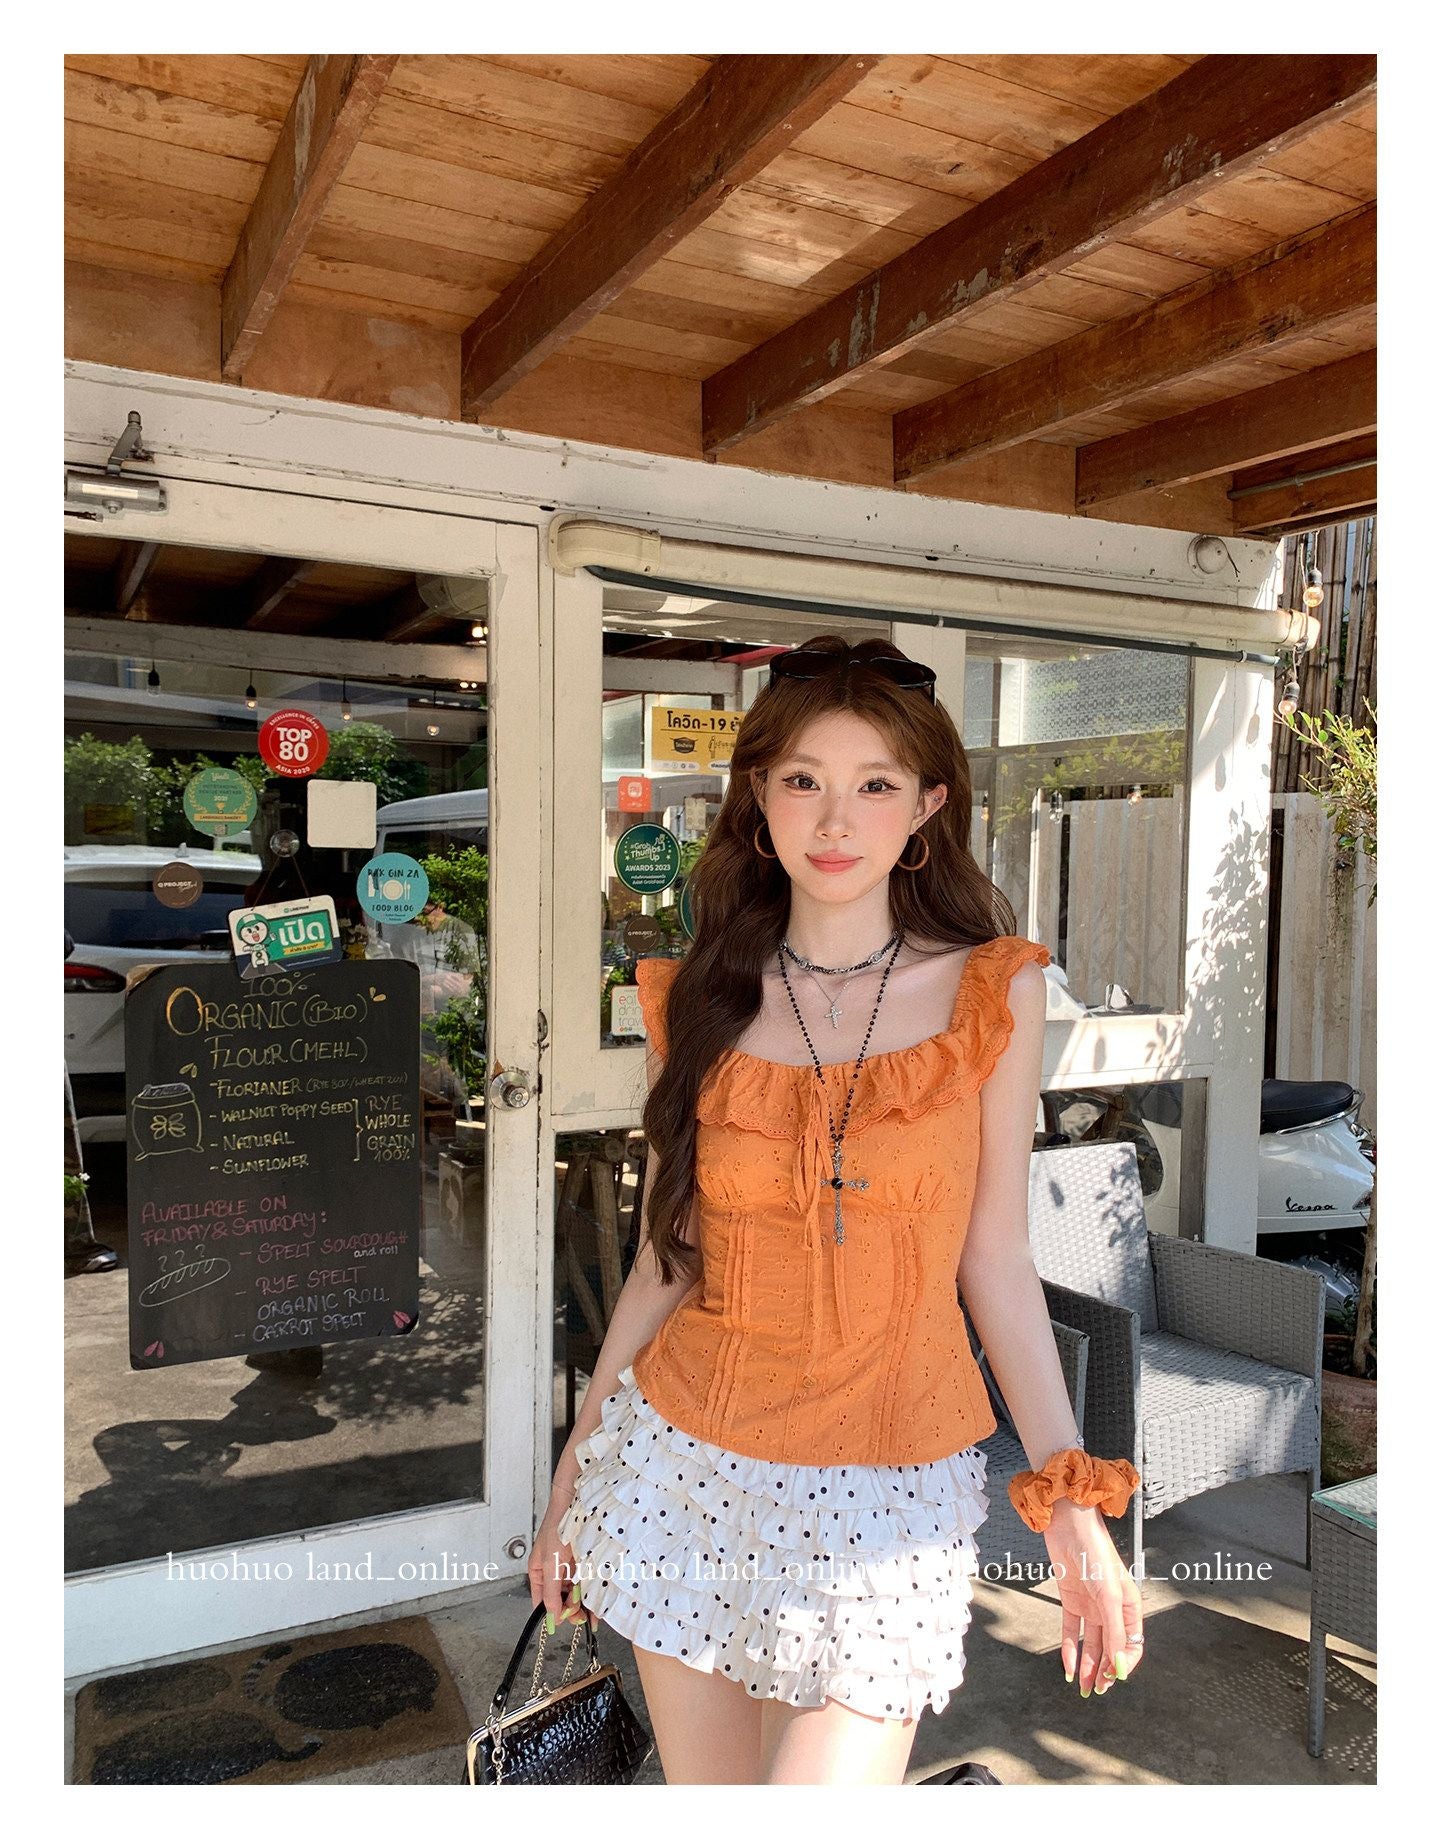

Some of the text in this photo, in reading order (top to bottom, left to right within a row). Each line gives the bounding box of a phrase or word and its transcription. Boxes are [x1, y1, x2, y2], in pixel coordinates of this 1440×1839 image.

[276, 727, 313, 743] TOP
[279, 741, 309, 762] 80
[275, 764, 311, 775] ASIA 2020
[388, 869, 404, 878] GIN
[278, 918, 325, 946] เปิด
[241, 971, 316, 998] 100%
[166, 987, 300, 1035] ORGANIC
[619, 1005, 642, 1016] drin
[619, 1018, 643, 1027] trav
[221, 1100, 354, 1123] WALNUT POPPY SEED
[365, 1094, 403, 1113] RYE
[365, 1114, 412, 1130] WHOLE
[223, 1131, 295, 1151] NATURAL
[367, 1133, 416, 1151] GRAIN
[222, 1154, 309, 1175] SUNFLOWER
[142, 1195, 287, 1224] AVAILABLE ON
[1286, 1196, 1338, 1212] Vespa
[257, 1242, 316, 1264] SPELT
[353, 1245, 398, 1259] and roll
[256, 1266, 367, 1296] RYE SPELT
[257, 1287, 391, 1322] ORGANIC ROLL
[252, 1312, 367, 1343] CARROT SPELT
